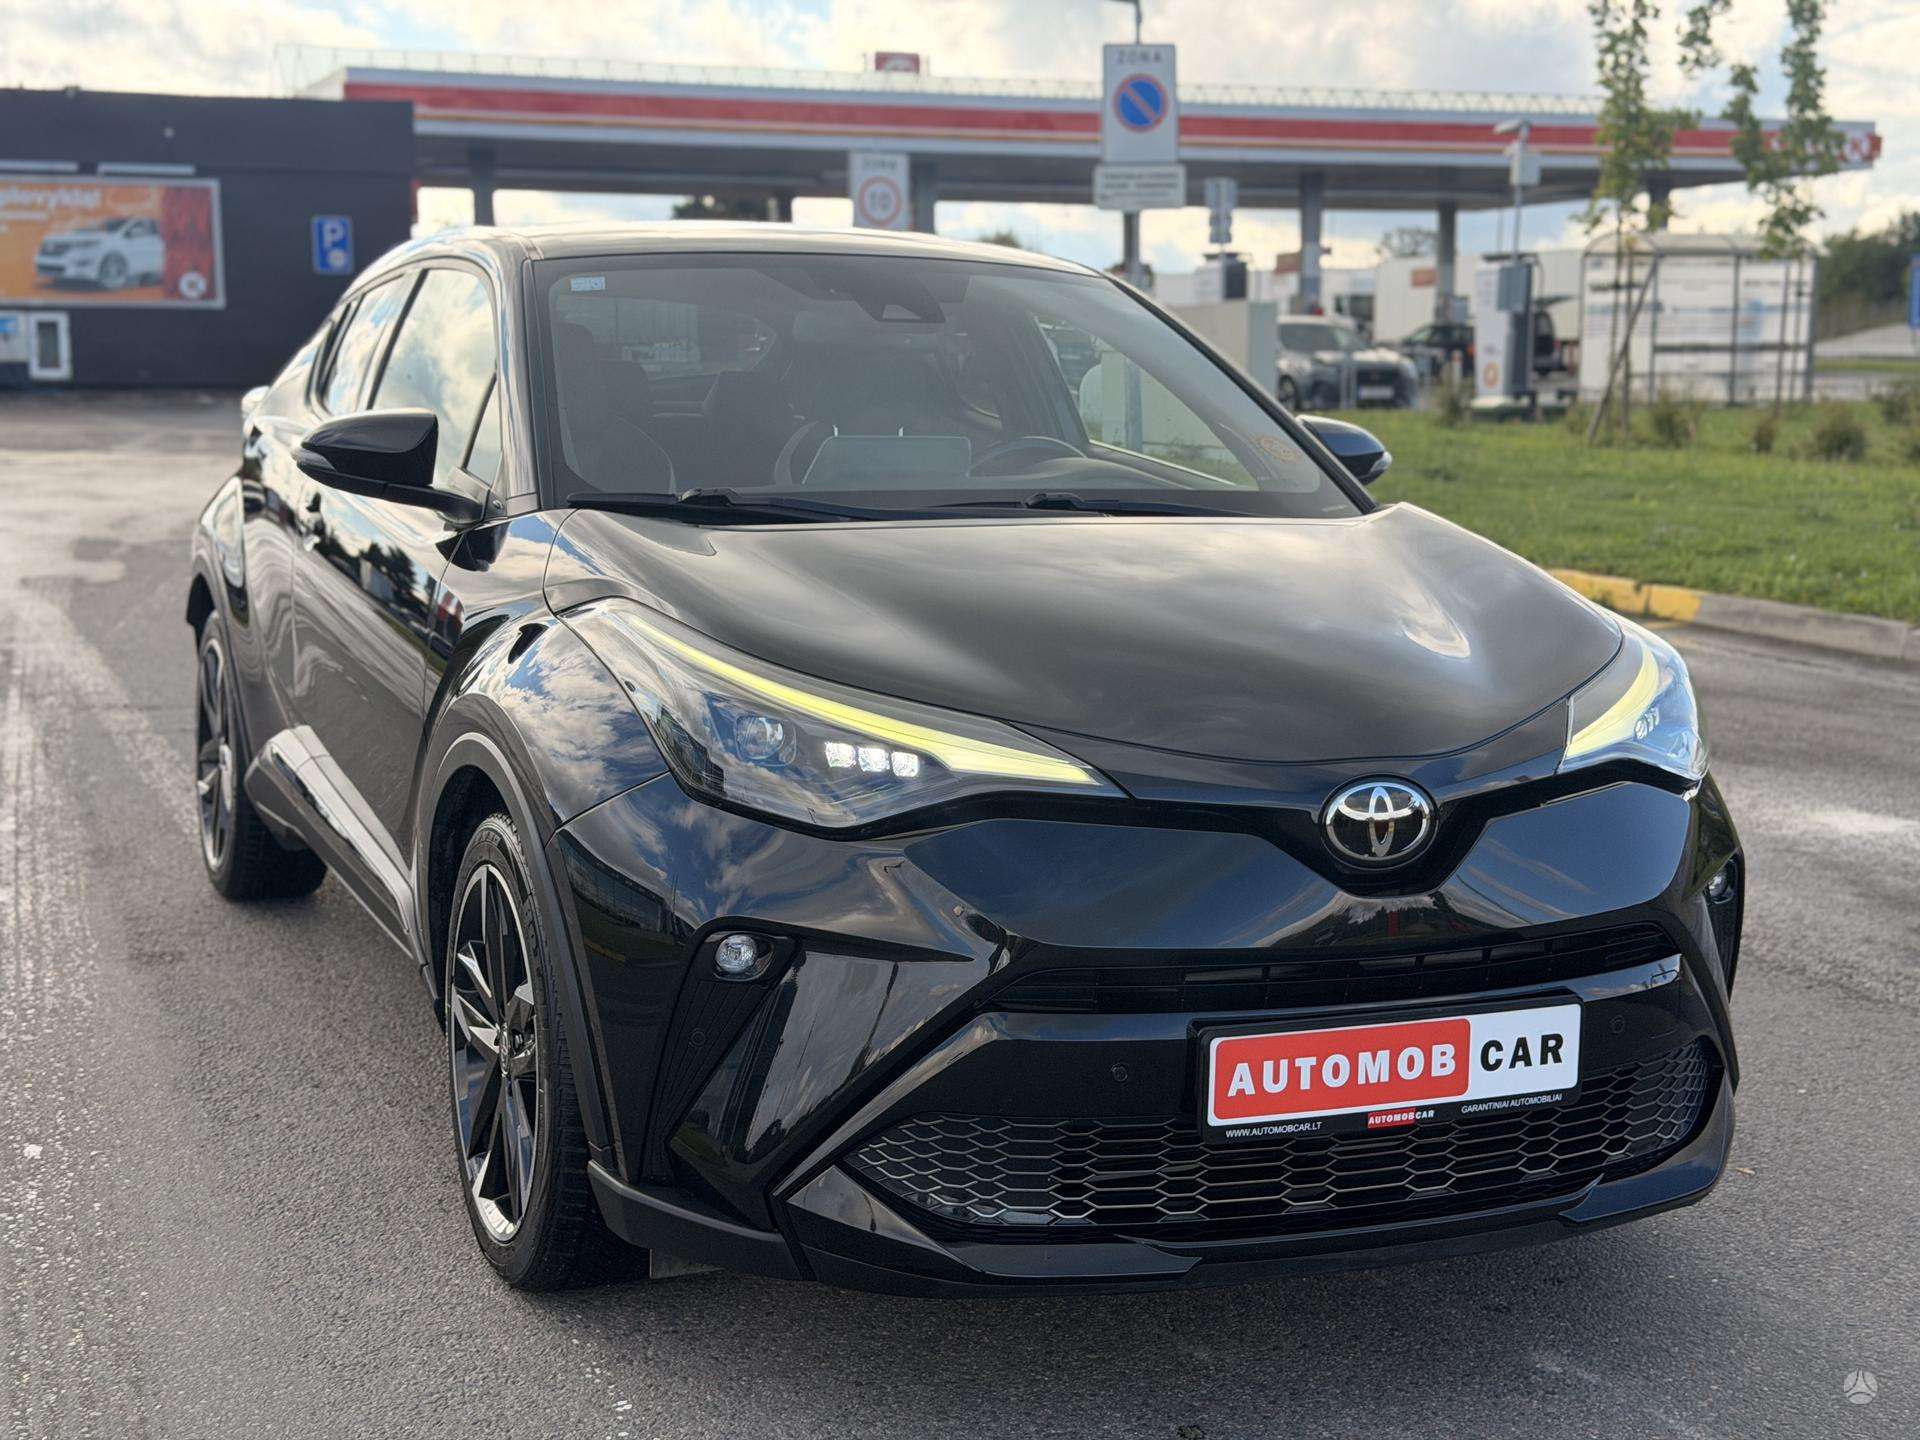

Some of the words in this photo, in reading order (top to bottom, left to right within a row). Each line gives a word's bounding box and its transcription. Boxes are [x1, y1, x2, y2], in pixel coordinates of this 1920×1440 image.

[1115, 50, 1163, 65] ZONA
[1227, 1044, 1456, 1097] AUTOMOB
[1480, 1033, 1565, 1072] CAR
[1461, 1101, 1510, 1114] GARANTINIAI
[1510, 1093, 1563, 1107] AUTOMOBILIAI
[1368, 1109, 1435, 1125] AUTOMOBCAR
[1225, 1121, 1323, 1138] WWW.AUTOMOBCAR.LT
